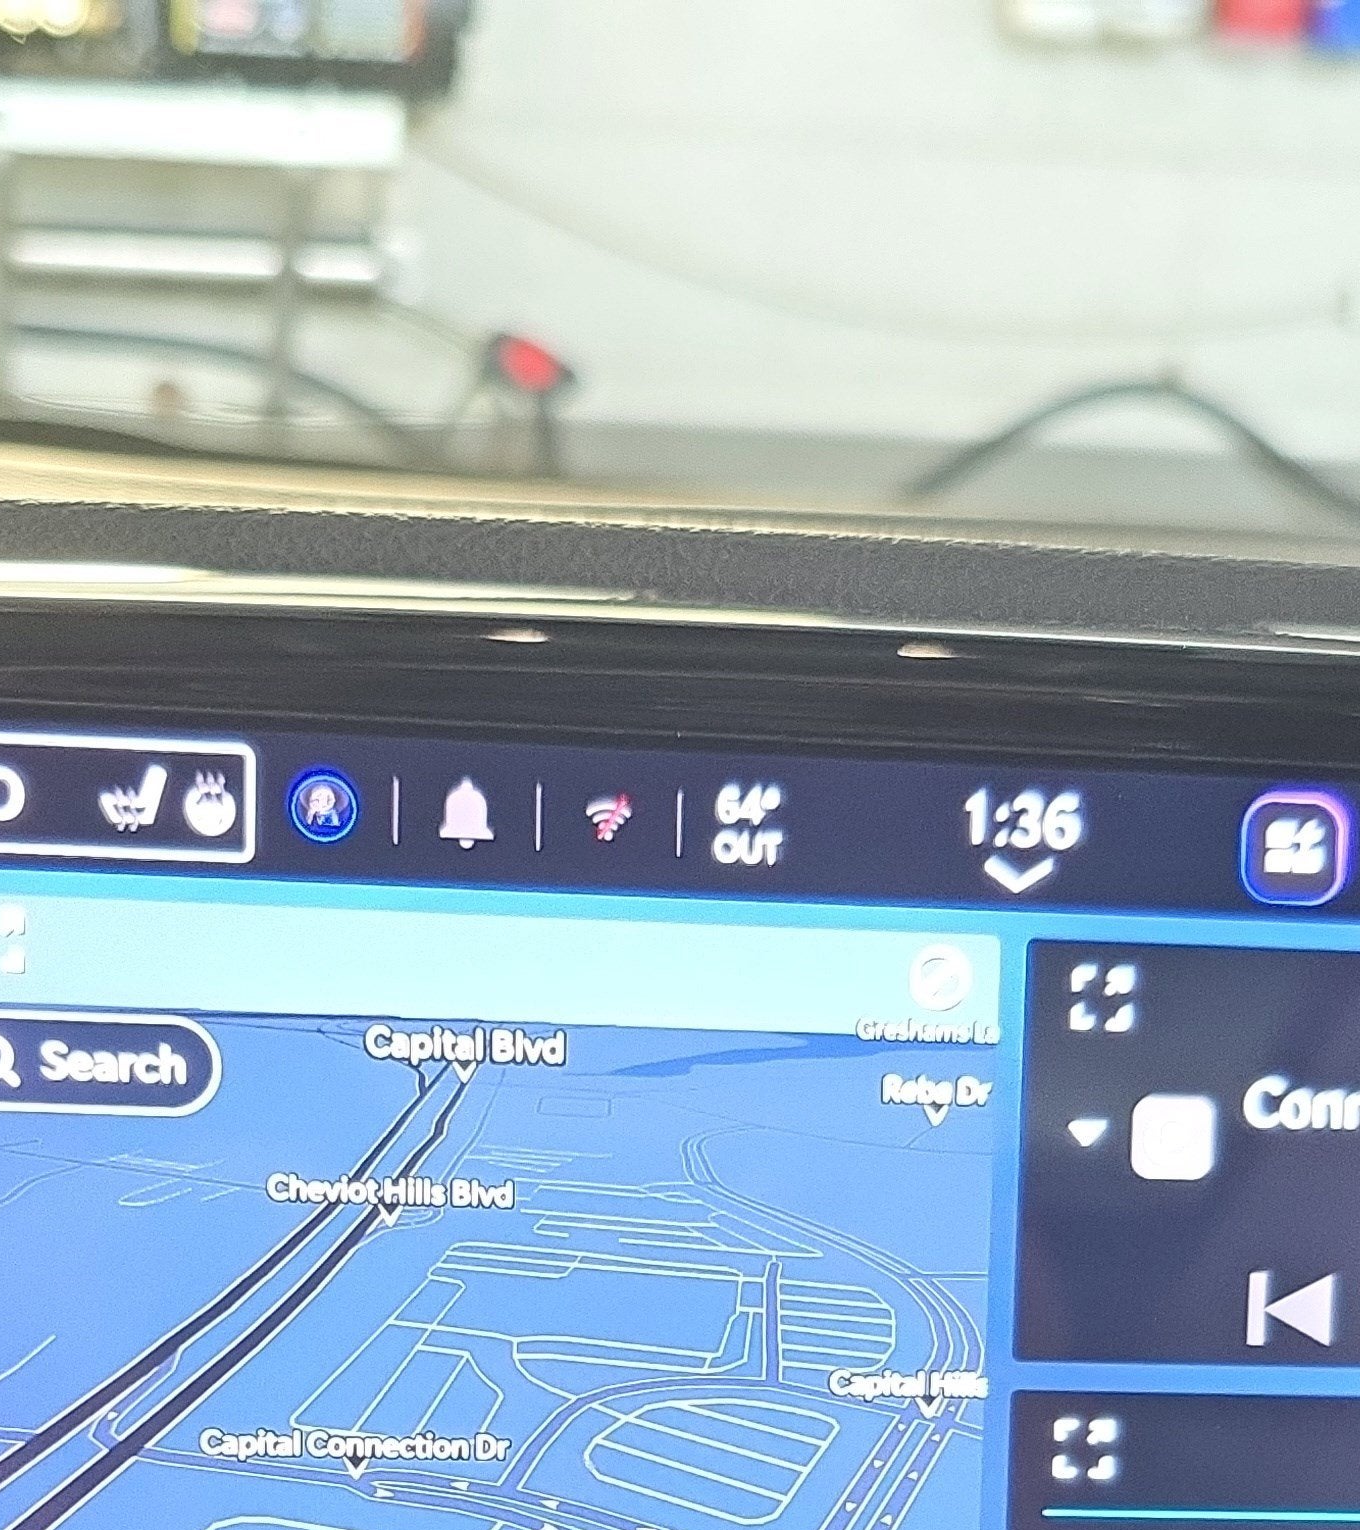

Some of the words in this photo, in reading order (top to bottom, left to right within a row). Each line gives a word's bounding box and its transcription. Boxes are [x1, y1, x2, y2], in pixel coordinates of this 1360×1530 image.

[964, 787, 1084, 851] 1:36
[713, 830, 783, 867] OUT
[39, 1039, 188, 1087] Search
[363, 1024, 484, 1065] Capital
[490, 1029, 568, 1067] Blvd
[955, 1075, 994, 1107] Dr
[265, 1172, 379, 1205] Cheviot
[383, 1176, 445, 1208] Hills
[451, 1179, 517, 1210] Blvd
[828, 1368, 926, 1402] Capital
[199, 1428, 302, 1460] Capital
[305, 1429, 470, 1462] Connection
[475, 1434, 513, 1463] Dr
